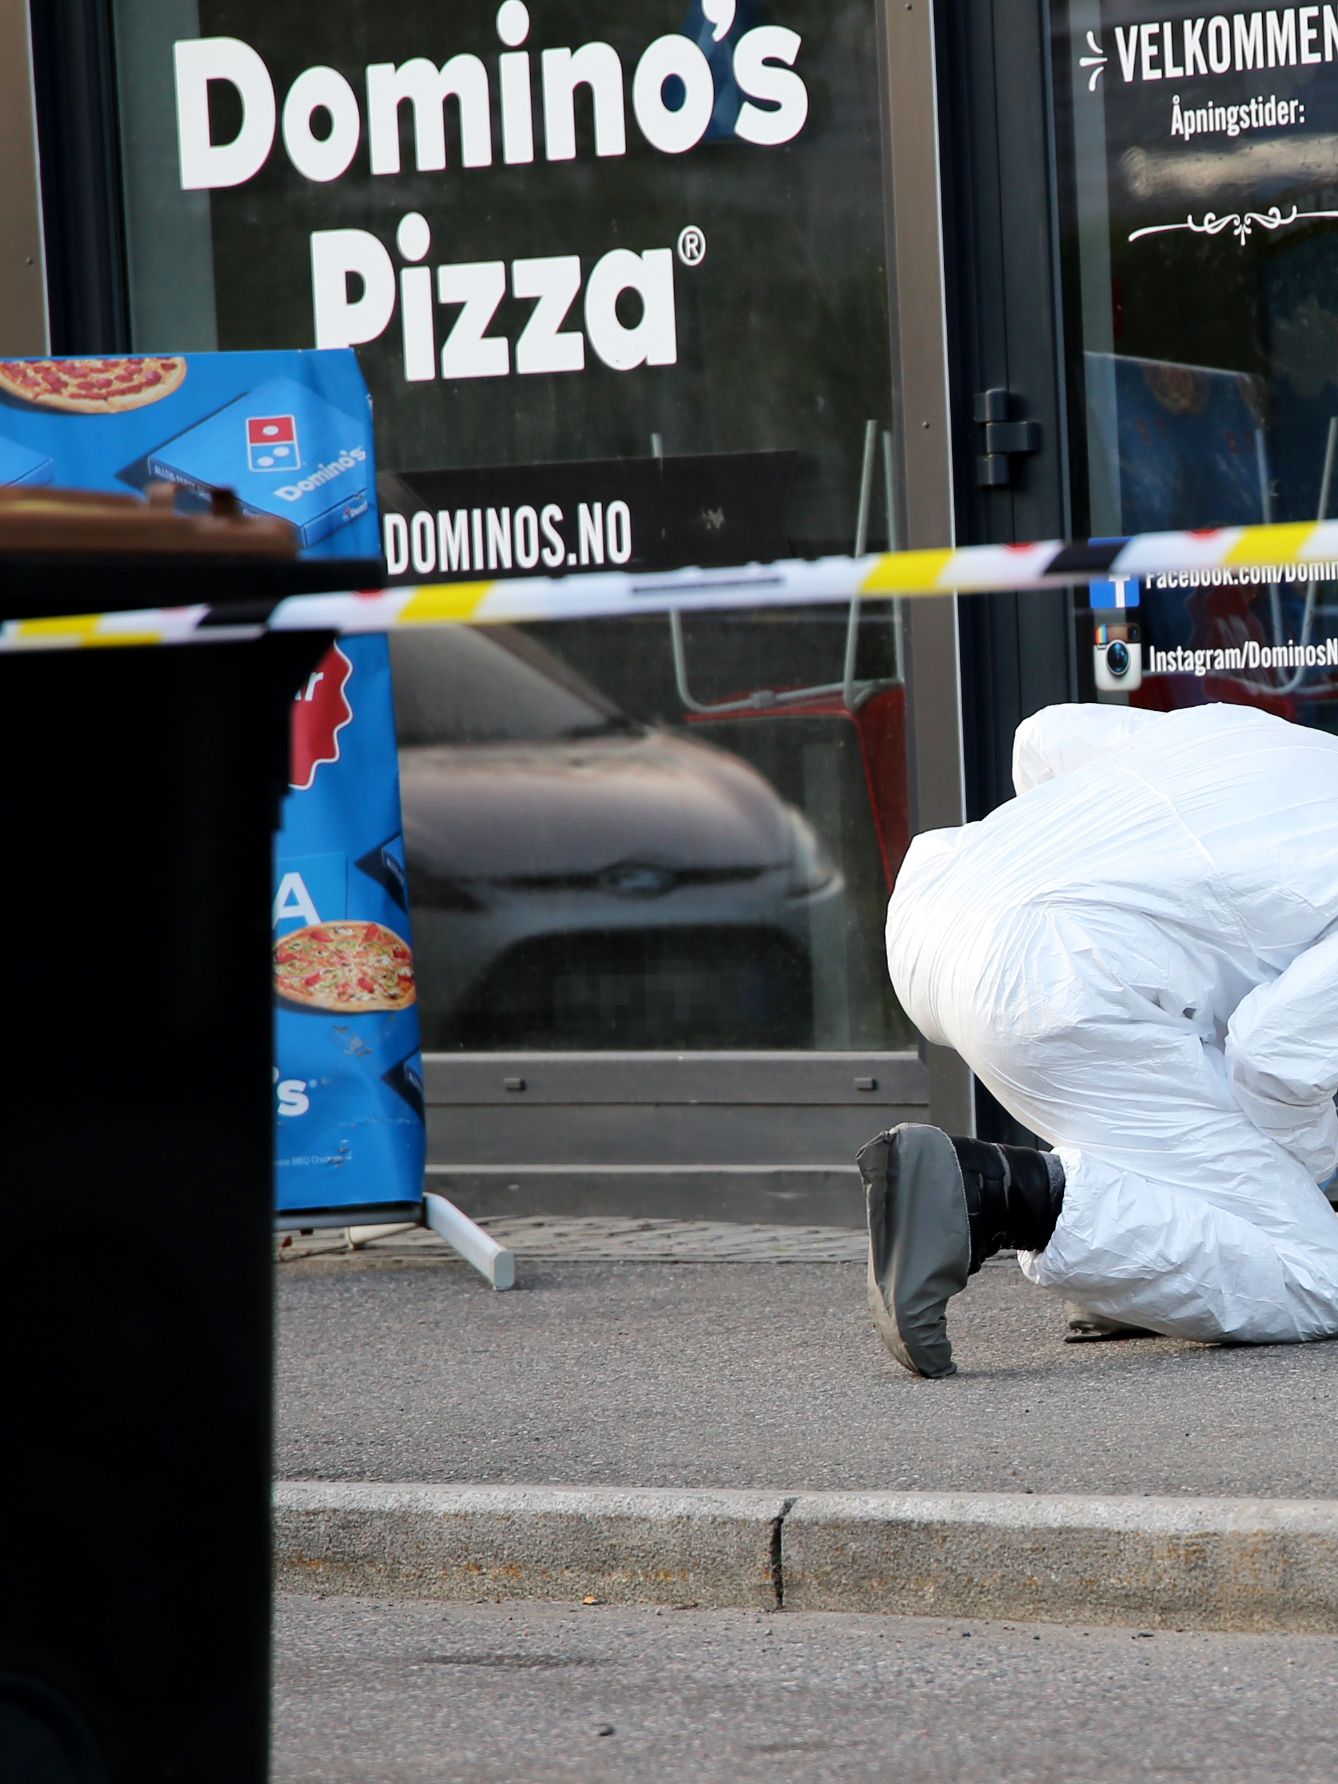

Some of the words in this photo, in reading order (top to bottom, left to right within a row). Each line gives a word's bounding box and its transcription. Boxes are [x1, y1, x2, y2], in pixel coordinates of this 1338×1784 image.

[174, 0, 809, 190] Domino's
[1171, 95, 1305, 140] Åpningstider:
[385, 501, 632, 574] DOMINOS.NO
